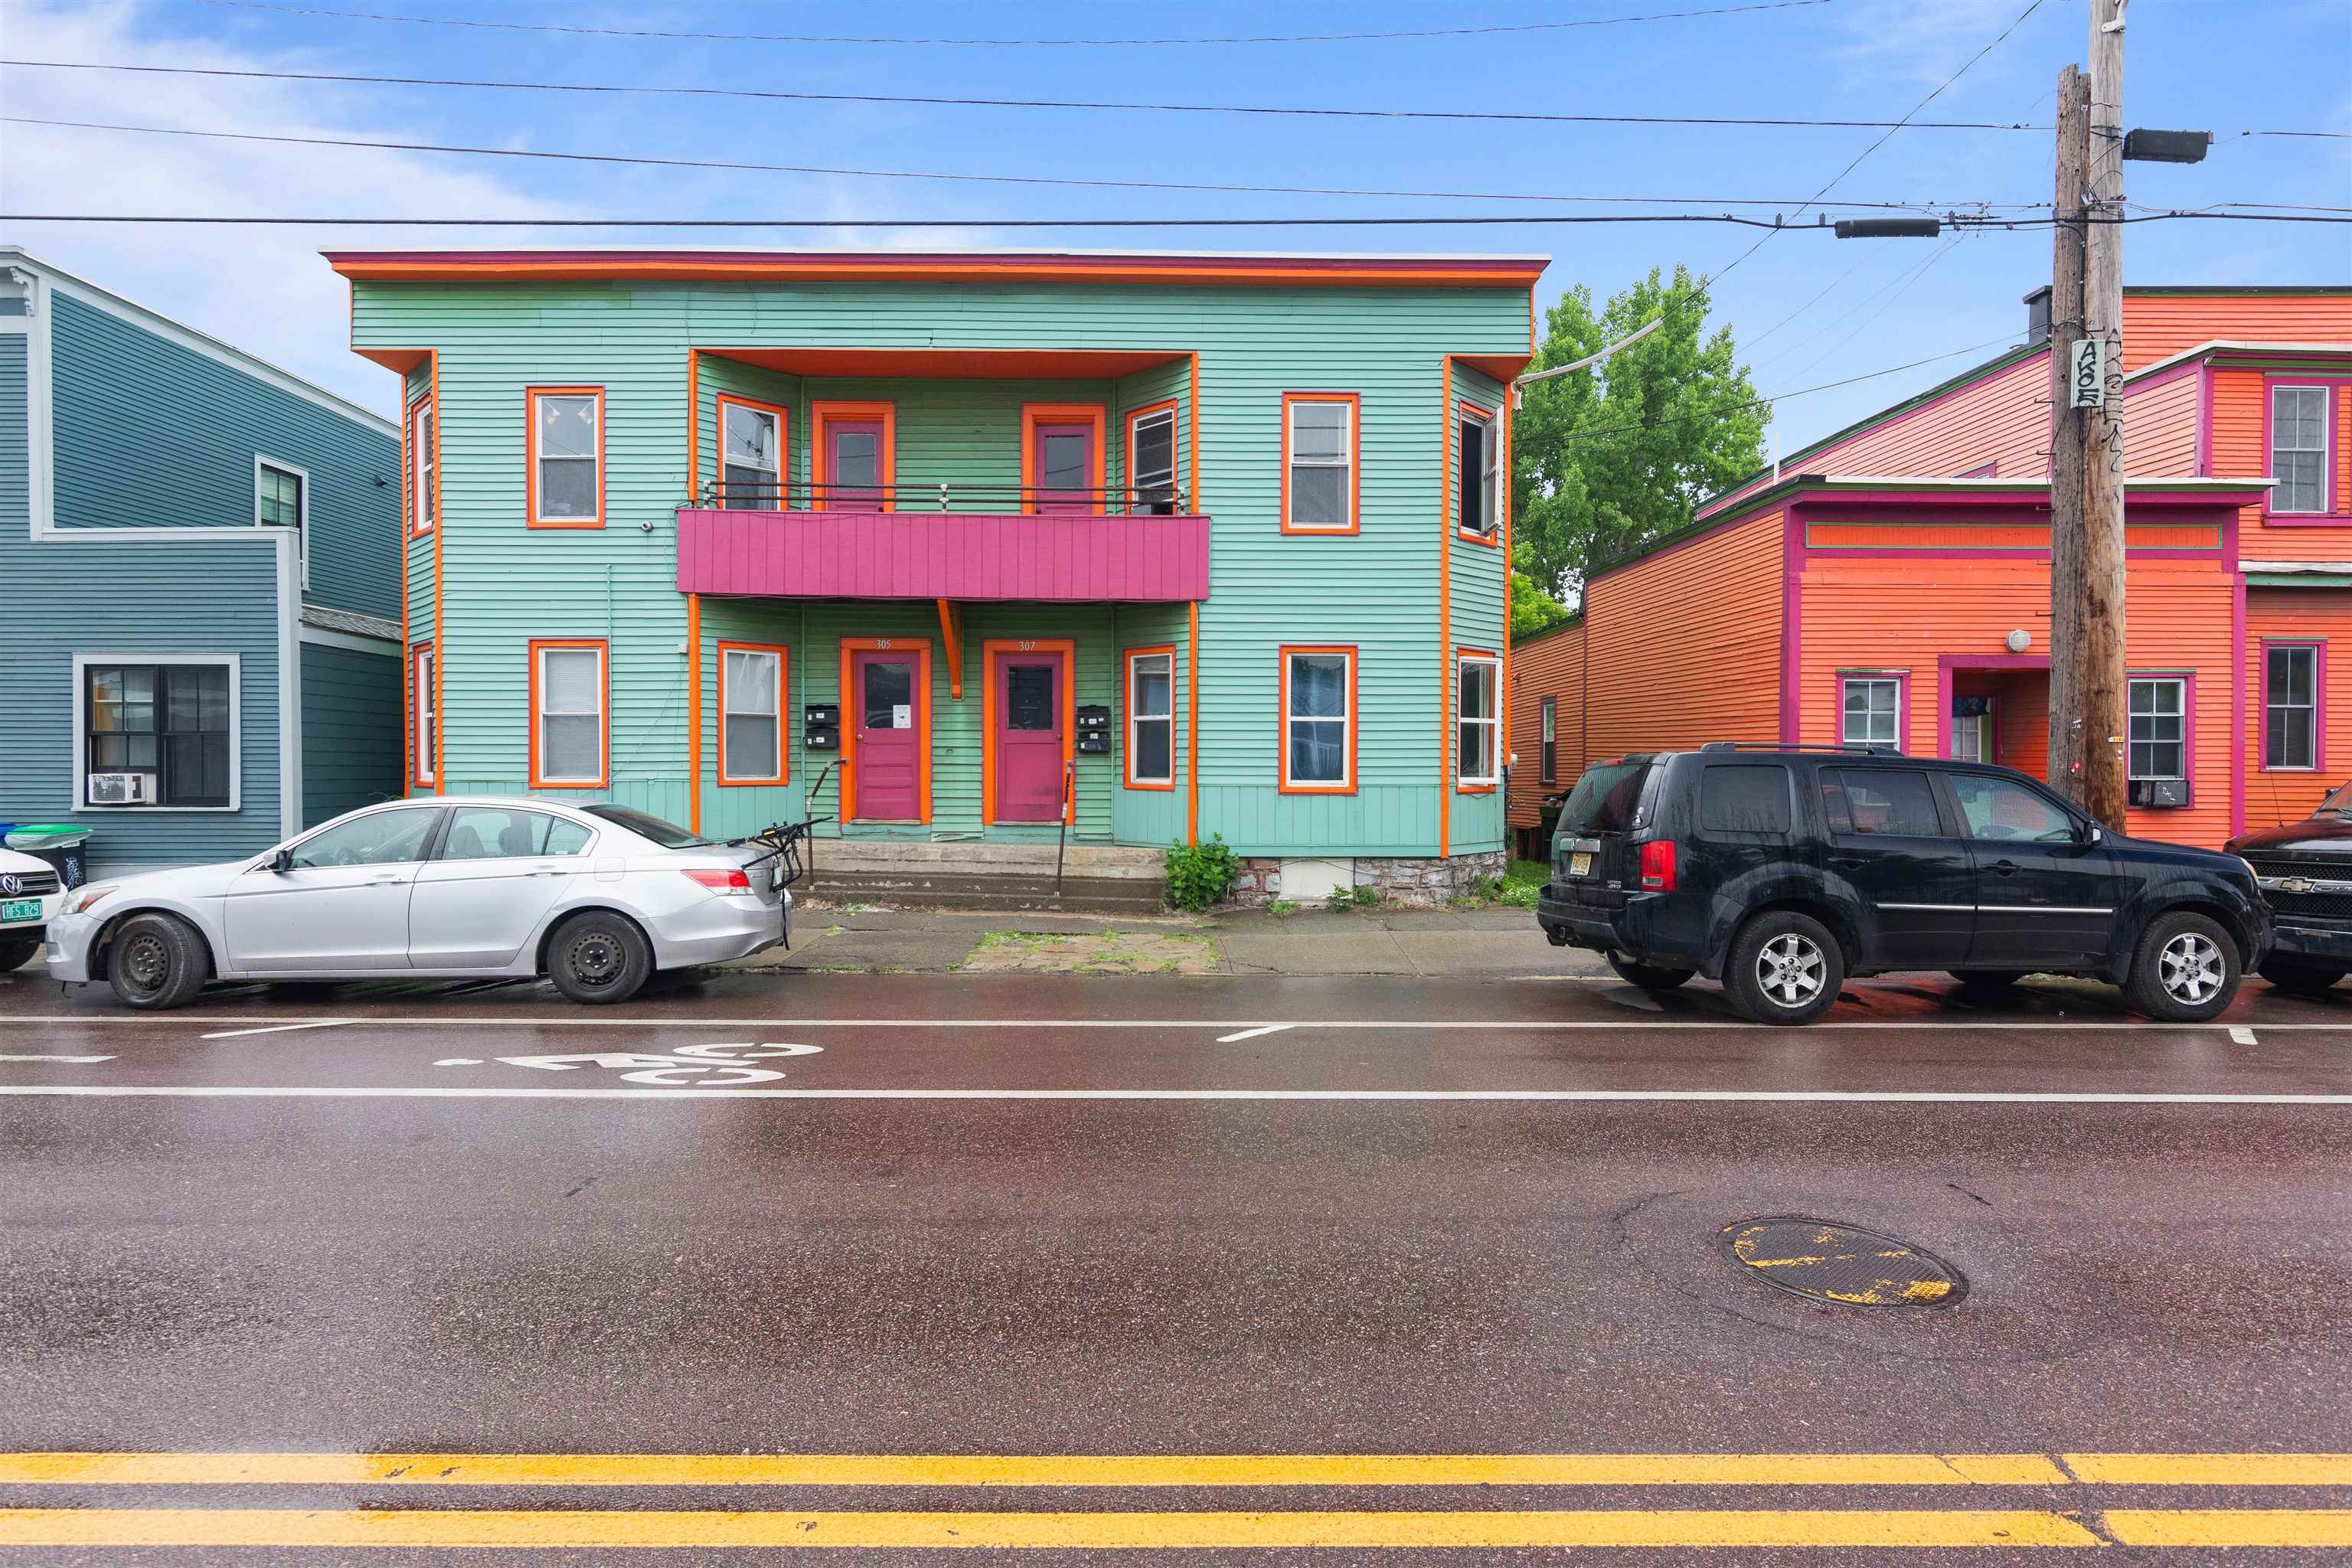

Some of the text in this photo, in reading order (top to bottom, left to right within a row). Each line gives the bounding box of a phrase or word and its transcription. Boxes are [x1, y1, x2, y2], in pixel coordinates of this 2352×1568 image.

[876, 639, 891, 650] 305
[1019, 641, 1036, 651] 307
[24, 904, 39, 915] 829
